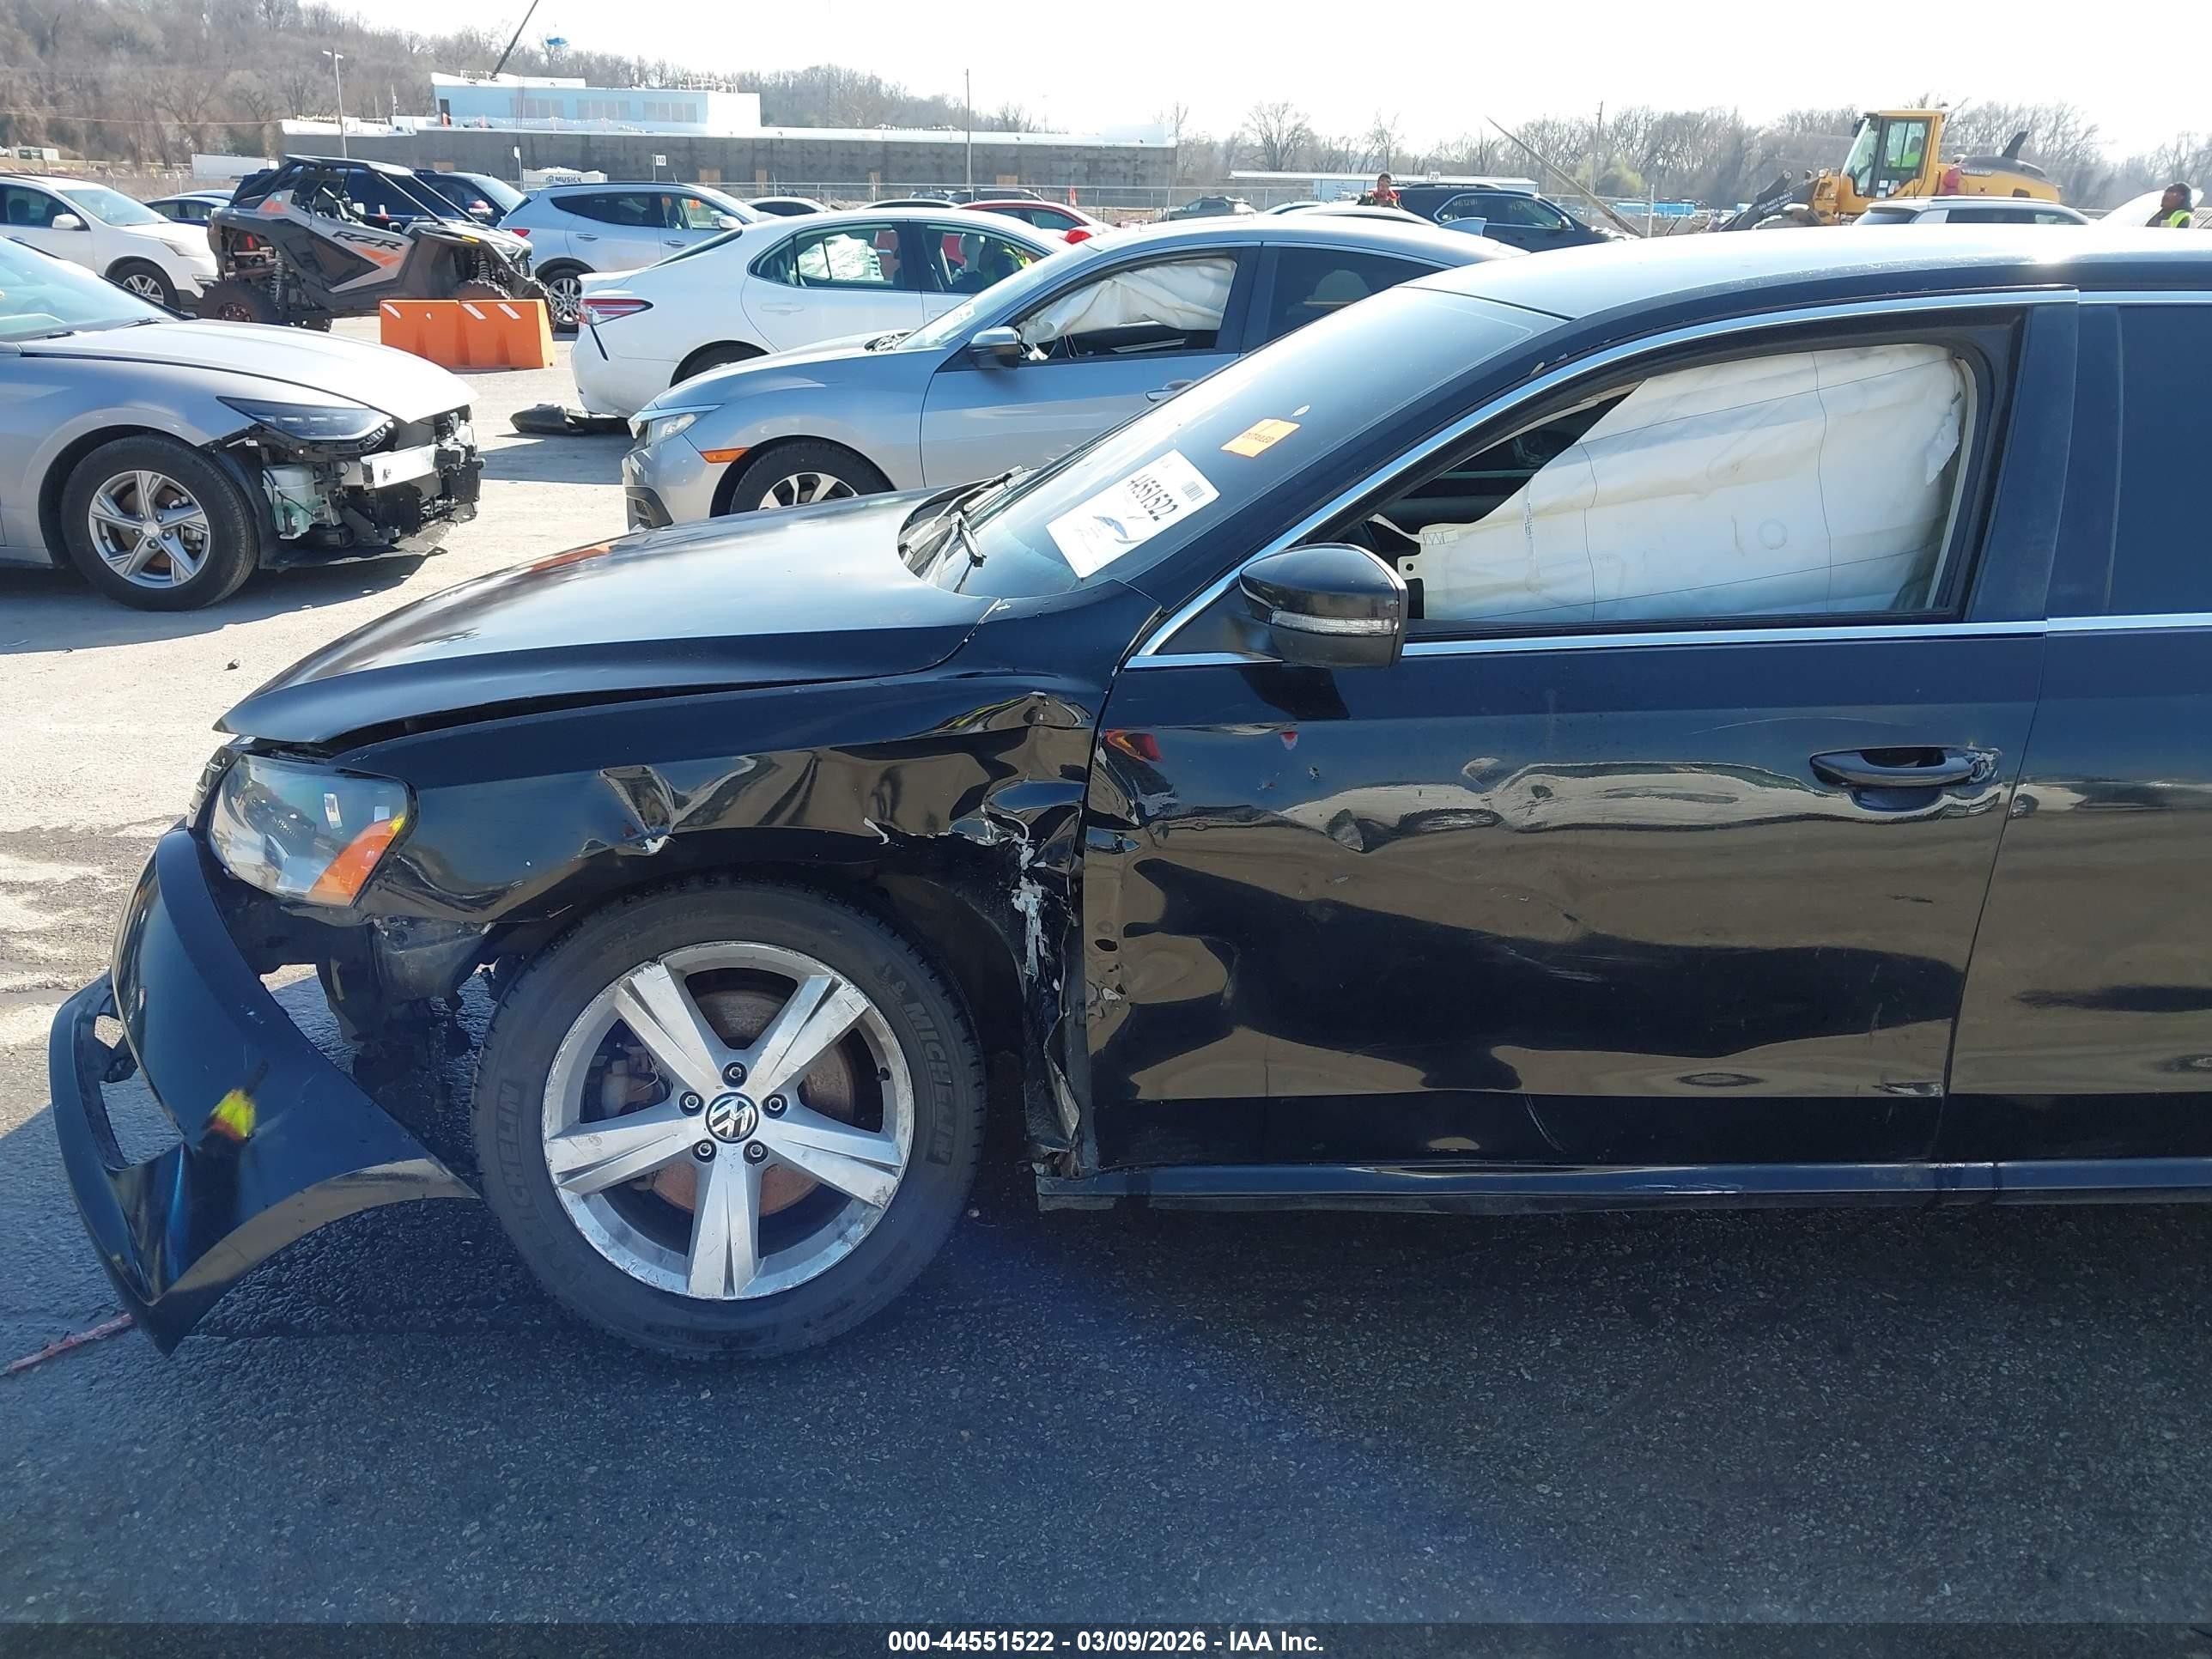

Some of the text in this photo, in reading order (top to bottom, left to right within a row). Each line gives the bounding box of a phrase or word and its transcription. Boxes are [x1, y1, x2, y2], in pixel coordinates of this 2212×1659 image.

[1779, 191, 1793, 201] WALK
[332, 231, 404, 251] RZR
[1127, 474, 1179, 521] 44551522
[903, 1002, 954, 1161] MICHELIN
